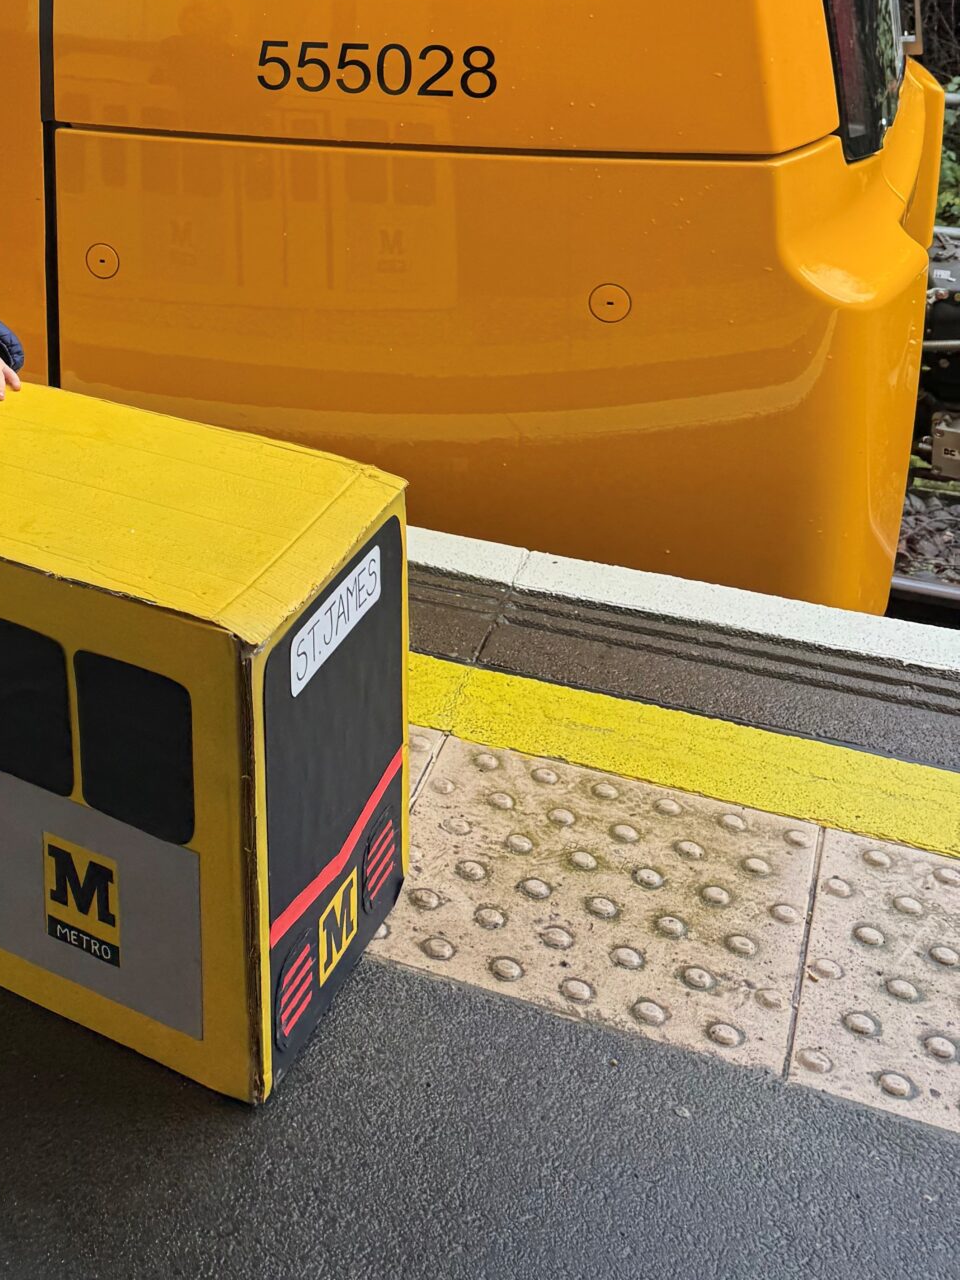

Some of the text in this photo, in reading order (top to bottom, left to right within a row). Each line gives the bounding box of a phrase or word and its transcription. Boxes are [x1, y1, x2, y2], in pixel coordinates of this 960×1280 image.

[257, 40, 497, 99] 555028
[48, 843, 116, 928] M
[56, 924, 112, 960] METRO
[323, 878, 354, 974] M
